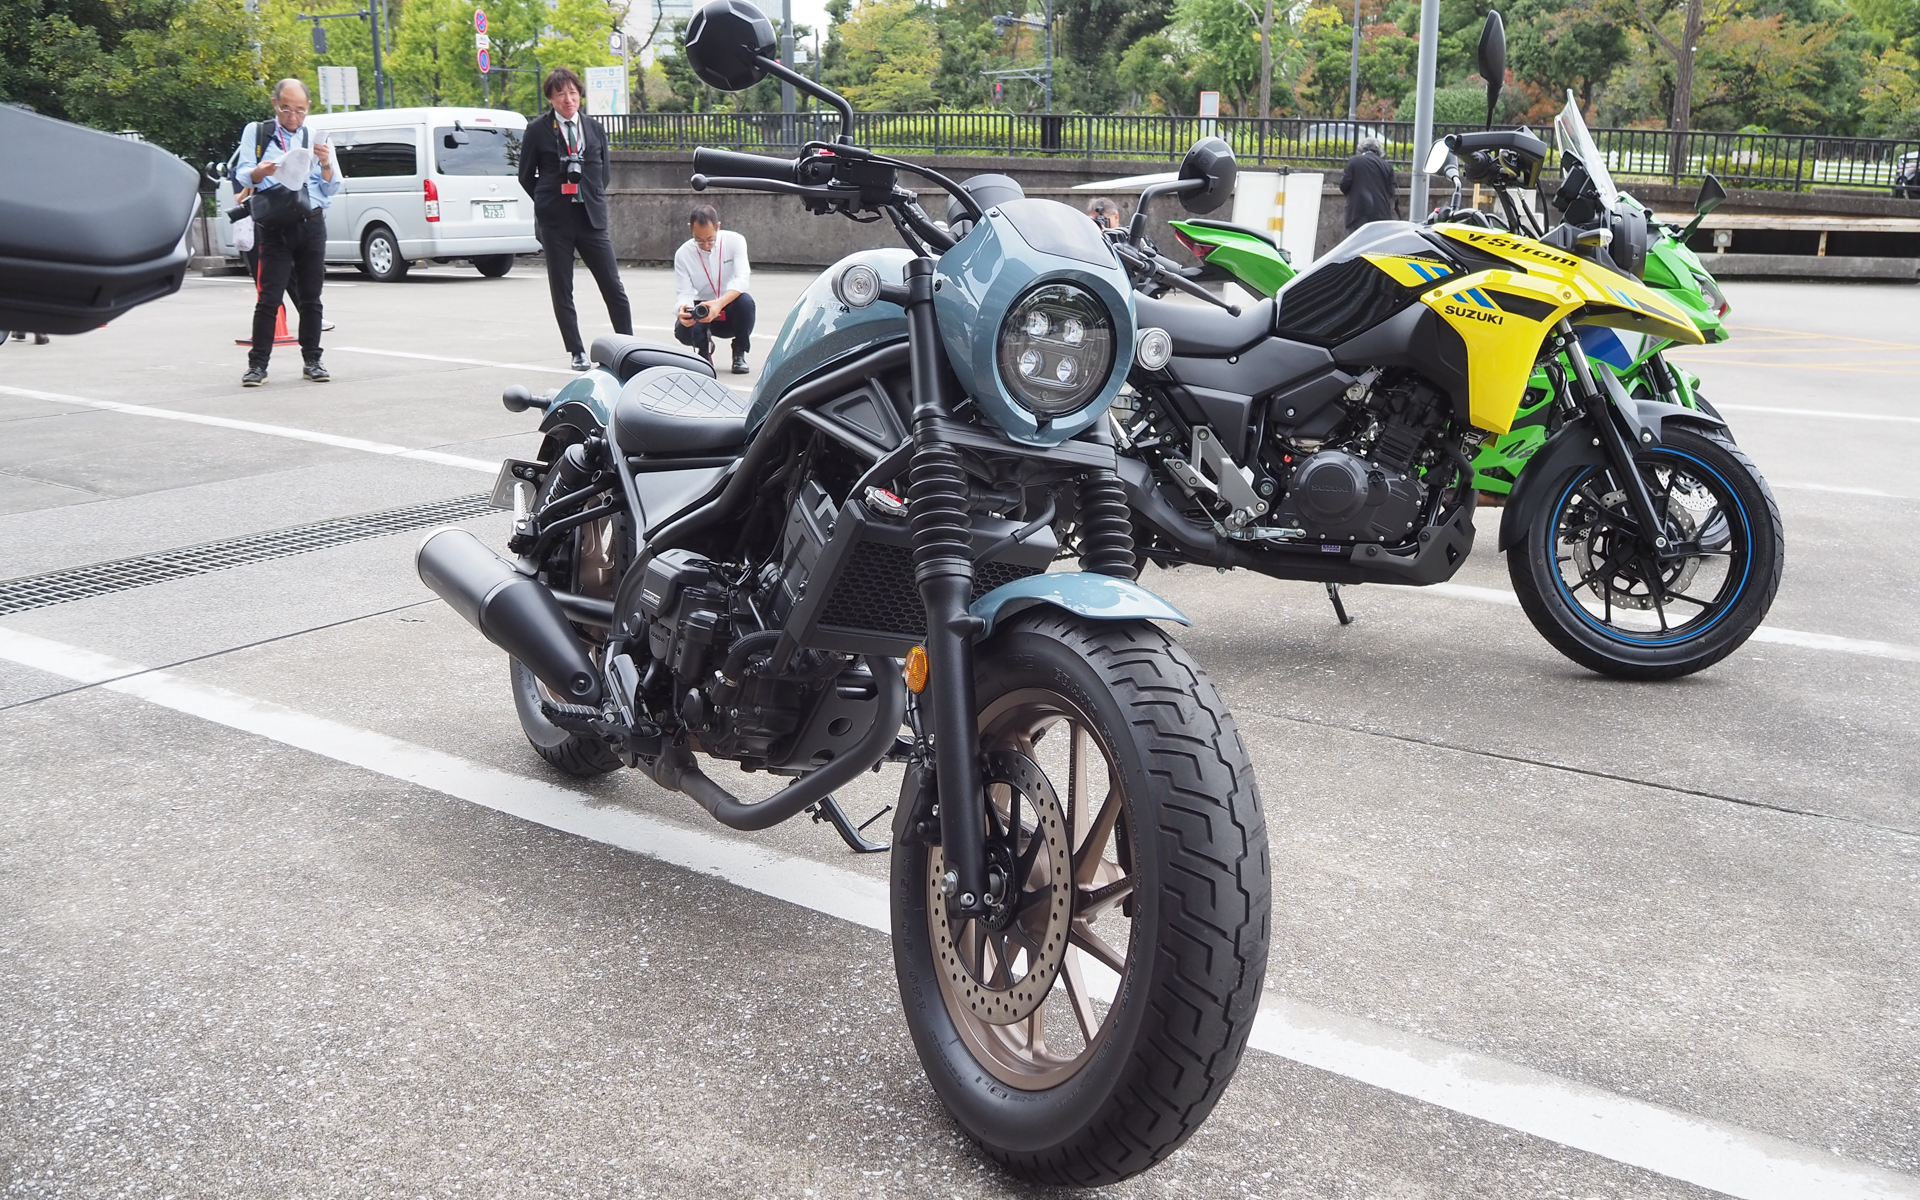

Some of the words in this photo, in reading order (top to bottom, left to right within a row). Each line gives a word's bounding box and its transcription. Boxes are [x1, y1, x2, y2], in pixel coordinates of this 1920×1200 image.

[1468, 233, 1577, 267] V-Strom
[1444, 305, 1504, 326] SUZUKI
[1311, 484, 1349, 493] SUZUKI
